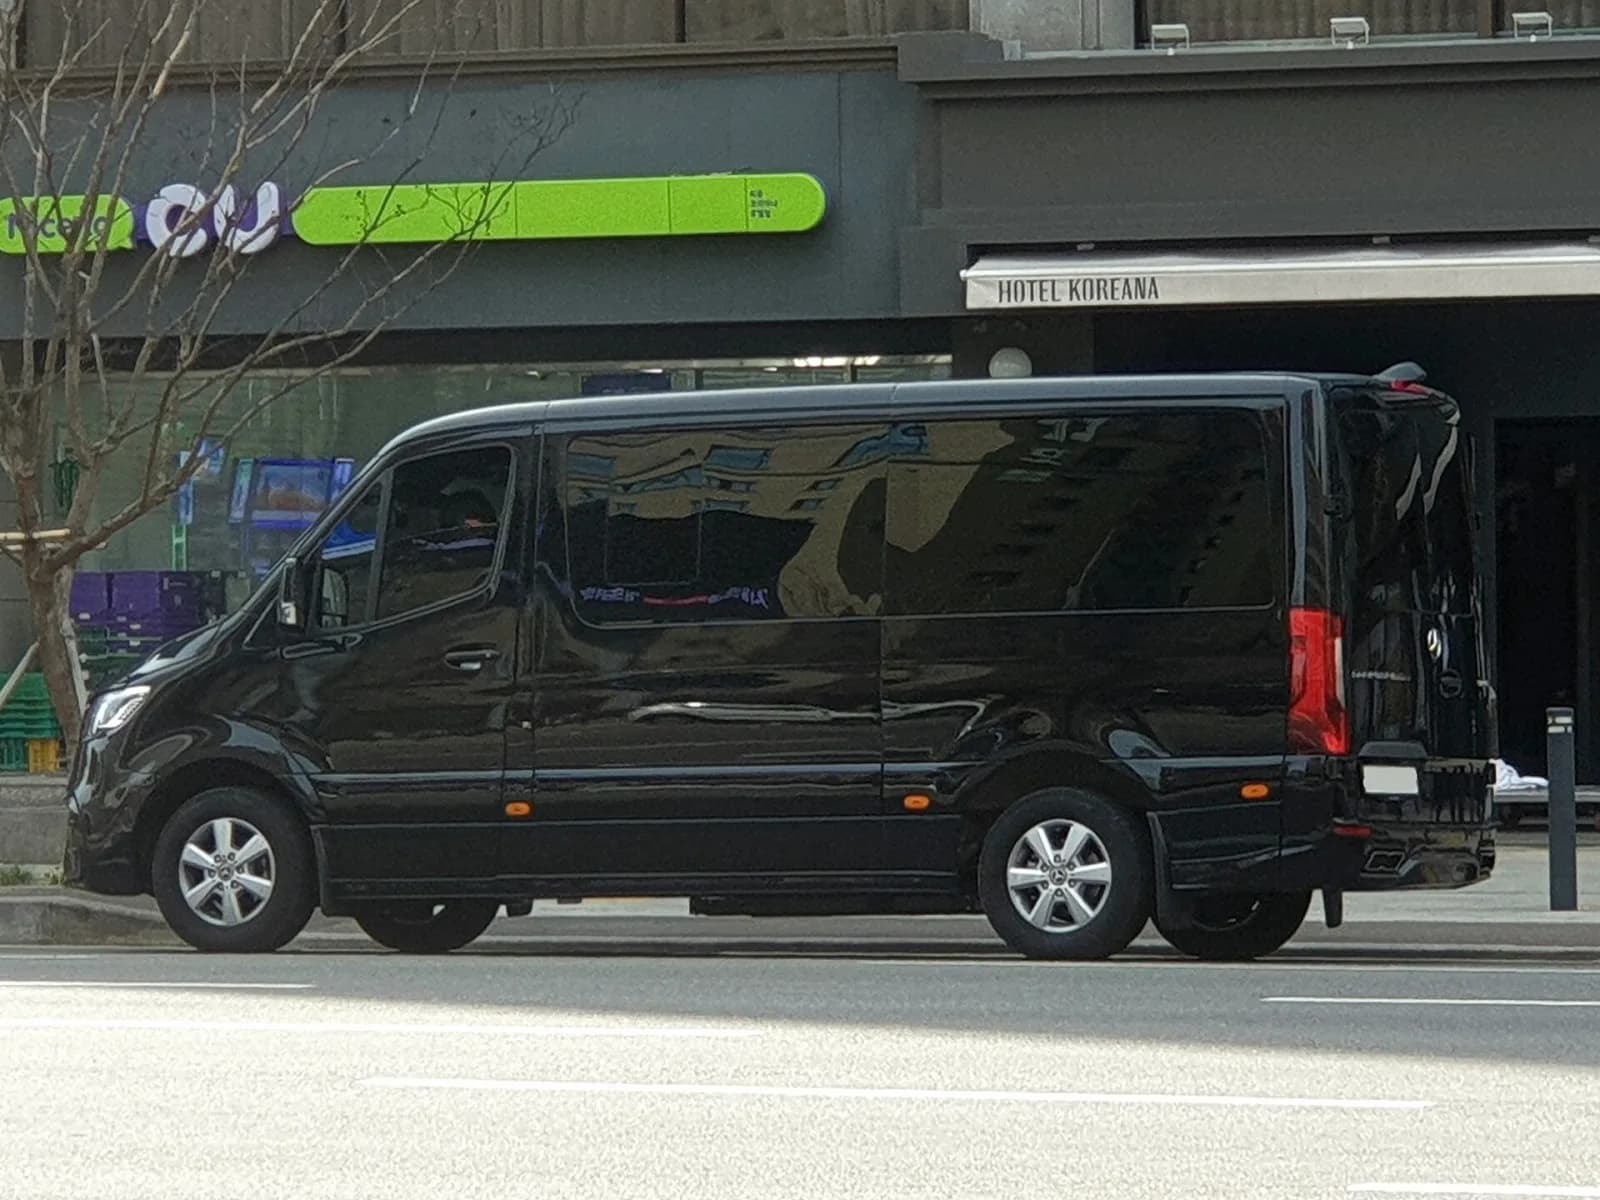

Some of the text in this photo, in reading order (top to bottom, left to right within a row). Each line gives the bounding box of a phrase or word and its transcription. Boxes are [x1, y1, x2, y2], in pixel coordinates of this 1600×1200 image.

[146, 181, 280, 257] CU
[998, 276, 1159, 303] HOTEL KOREANA
